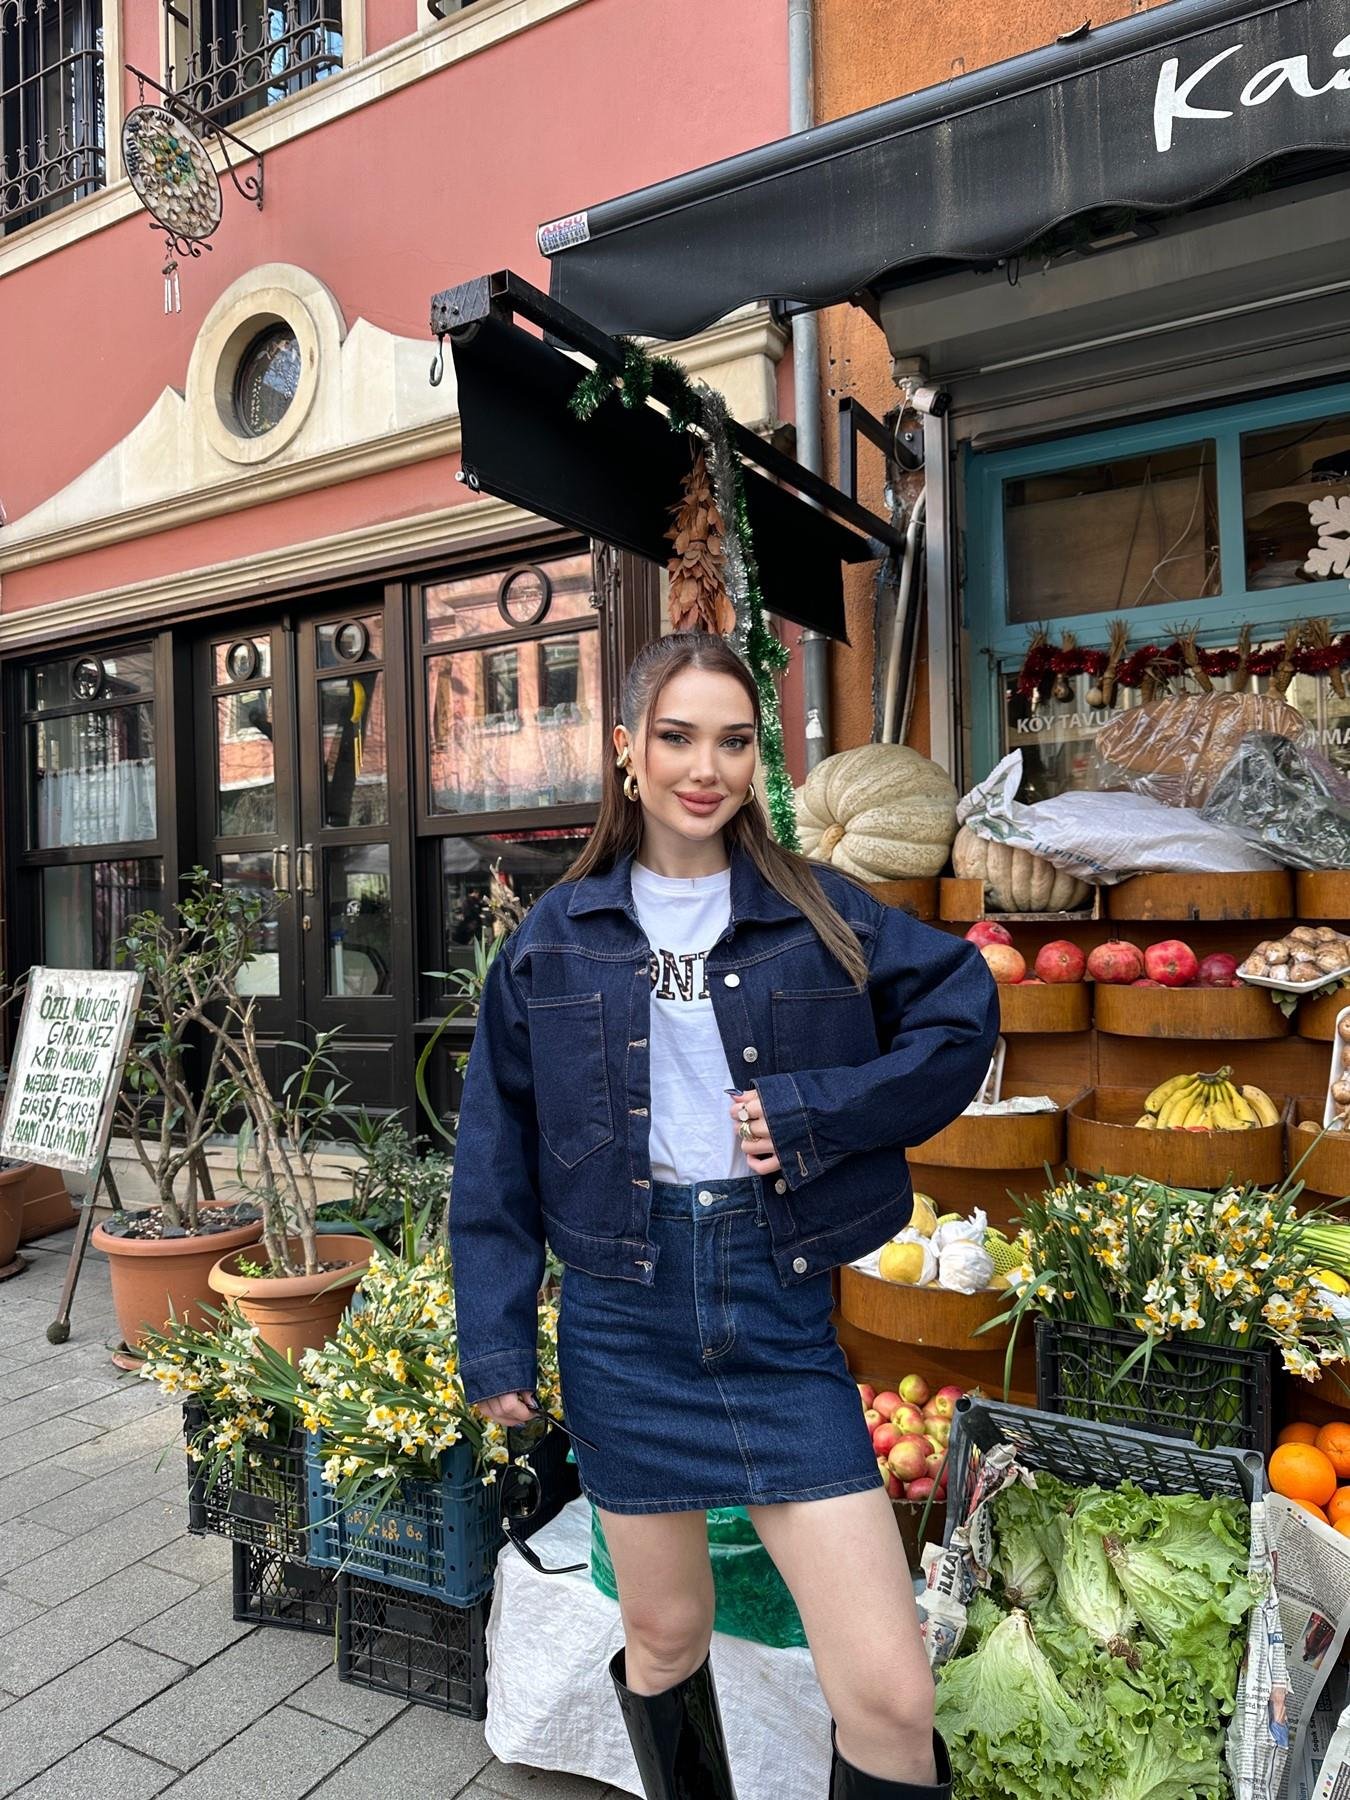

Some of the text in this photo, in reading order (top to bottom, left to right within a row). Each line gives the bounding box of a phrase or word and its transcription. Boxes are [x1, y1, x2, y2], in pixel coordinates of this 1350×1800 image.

[1016, 713, 1055, 734] KÖY
[40, 984, 71, 1020] ÖZEL
[47, 1020, 115, 1048] GİRİLMEZ
[30, 1045, 99, 1074] KAPI ÖNÜNÜ
[40, 1123, 91, 1159] OLMAYIN
